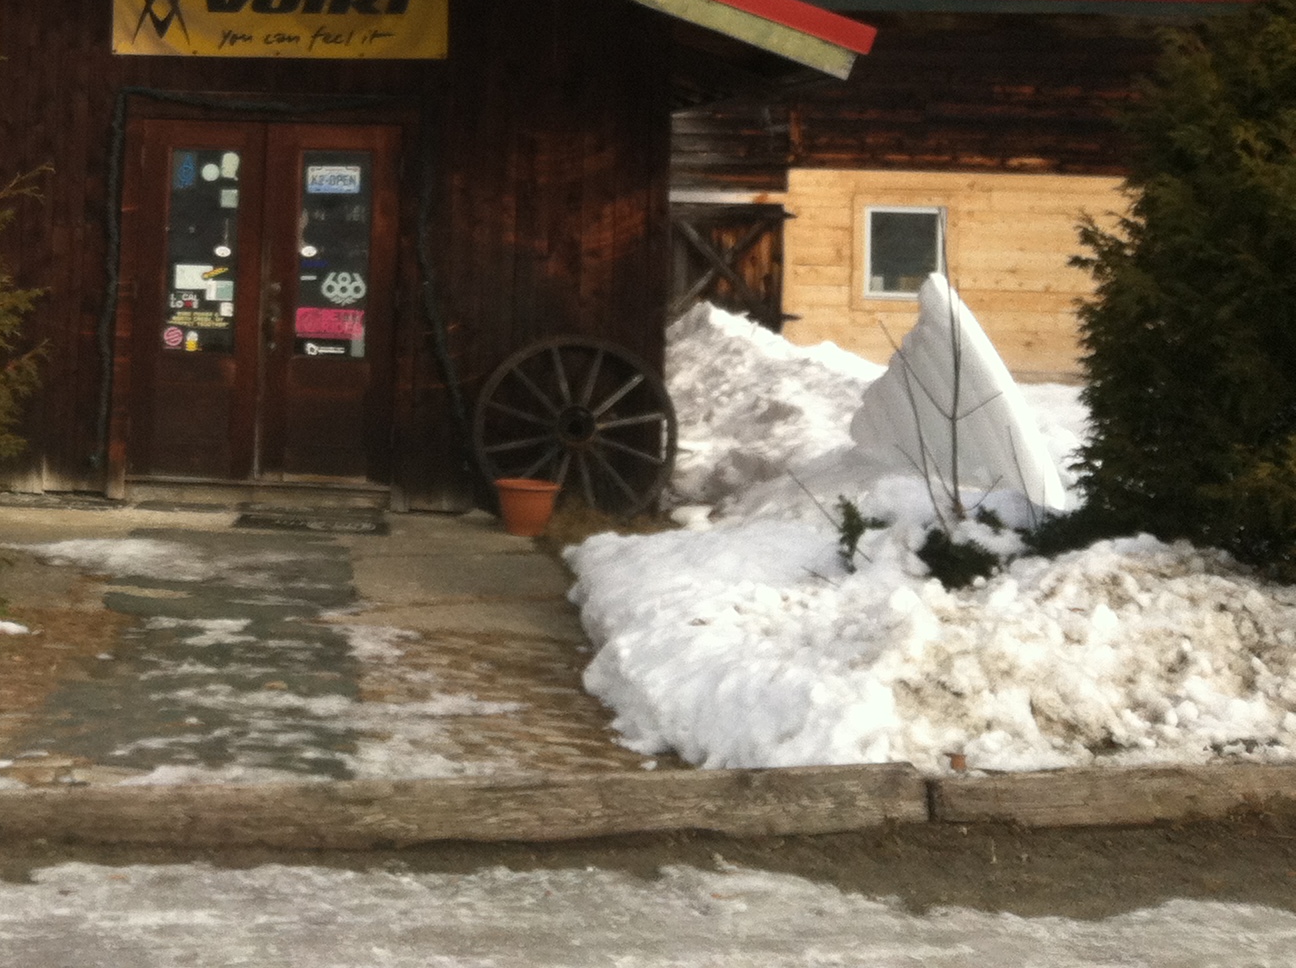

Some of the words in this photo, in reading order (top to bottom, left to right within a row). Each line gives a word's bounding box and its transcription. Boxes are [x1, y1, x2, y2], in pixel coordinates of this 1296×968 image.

[218, 28, 254, 50] you
[263, 32, 302, 46] can
[308, 26, 355, 52] feel
